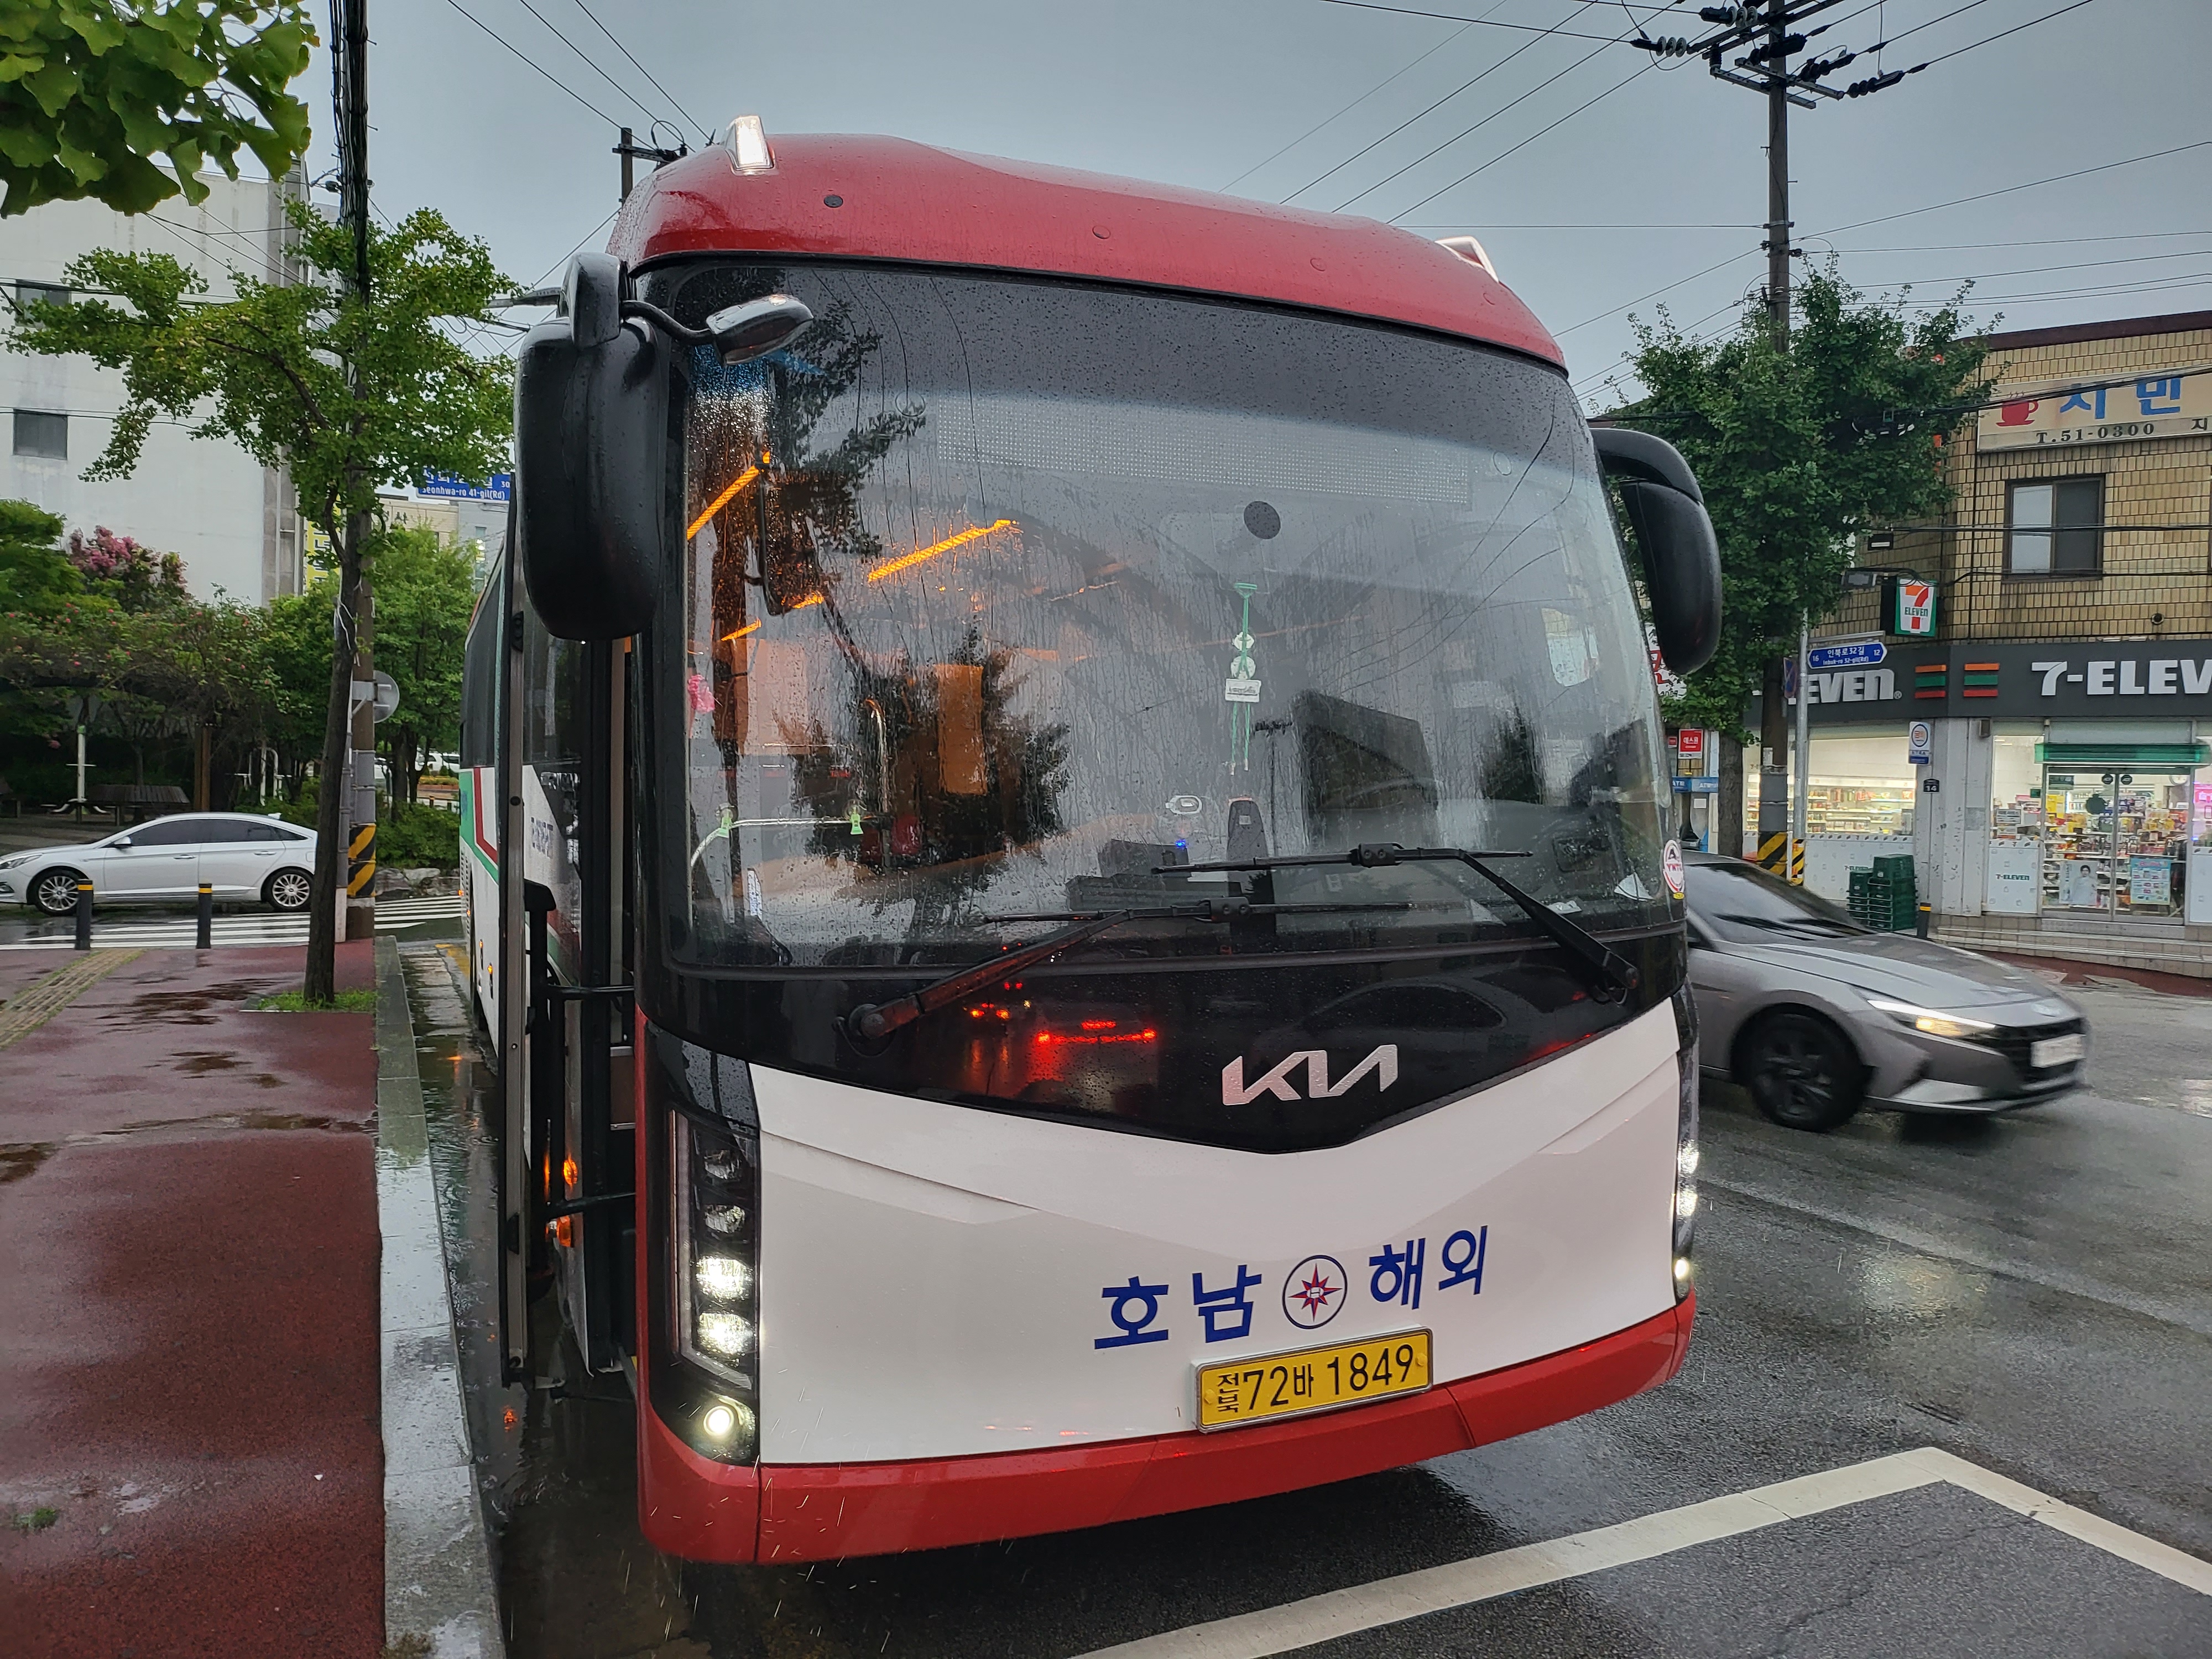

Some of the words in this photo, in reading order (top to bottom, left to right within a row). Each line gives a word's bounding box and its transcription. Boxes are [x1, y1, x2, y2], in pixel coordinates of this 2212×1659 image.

[2036, 423, 2155, 444] T.51-0300
[469, 488, 505, 500] 41-gil(Rd)
[1827, 646, 1865, 659] 인북로32길
[1222, 1044, 1399, 1106] KIA
[1368, 1225, 1489, 1310] 해외
[1094, 1264, 1262, 1350] 호남
[1243, 1363, 1314, 1410] 72바
[1327, 1344, 1414, 1396] 1849
